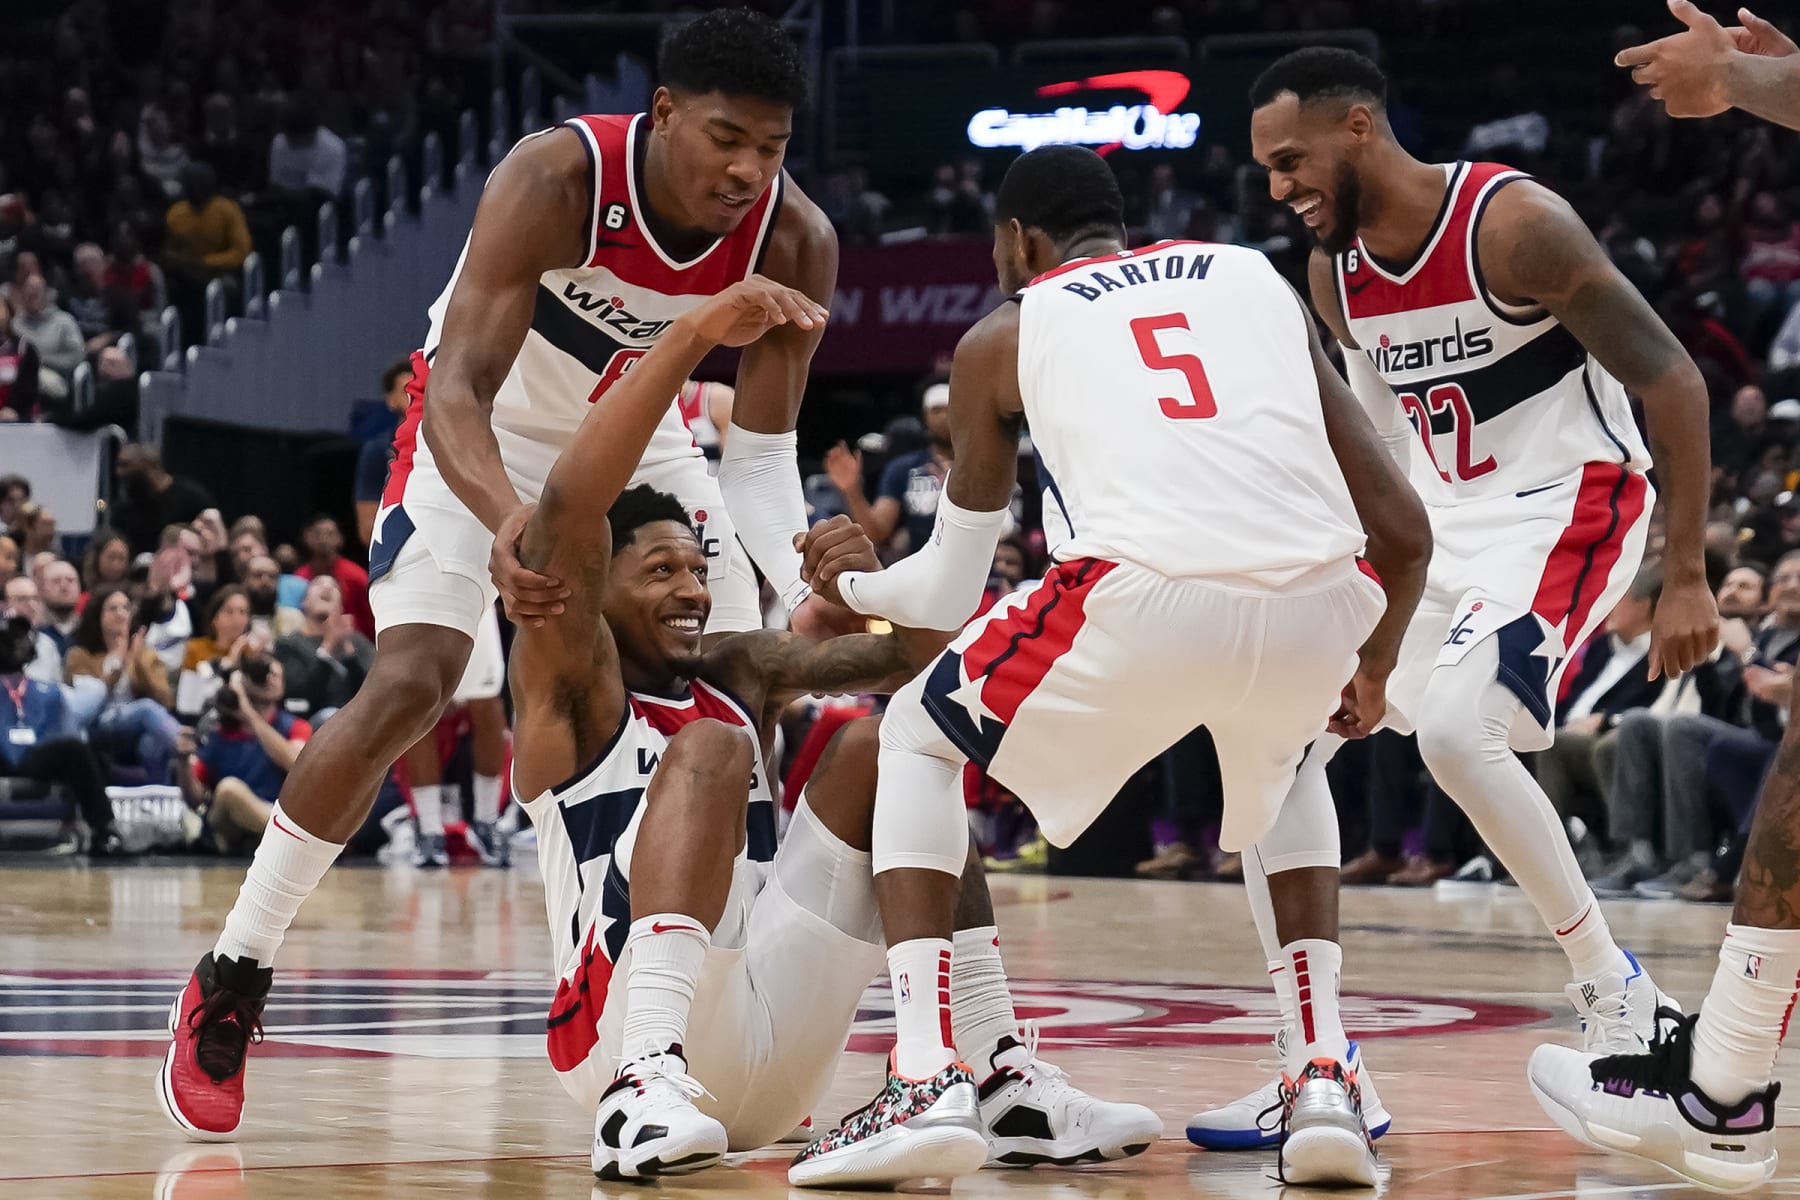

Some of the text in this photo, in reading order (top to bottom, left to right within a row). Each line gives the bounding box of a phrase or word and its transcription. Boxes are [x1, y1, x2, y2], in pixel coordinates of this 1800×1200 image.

[605, 204, 626, 230] 6
[1062, 254, 1215, 302] BARTON
[1347, 249, 1359, 273] 6
[1129, 312, 1218, 420] 5
